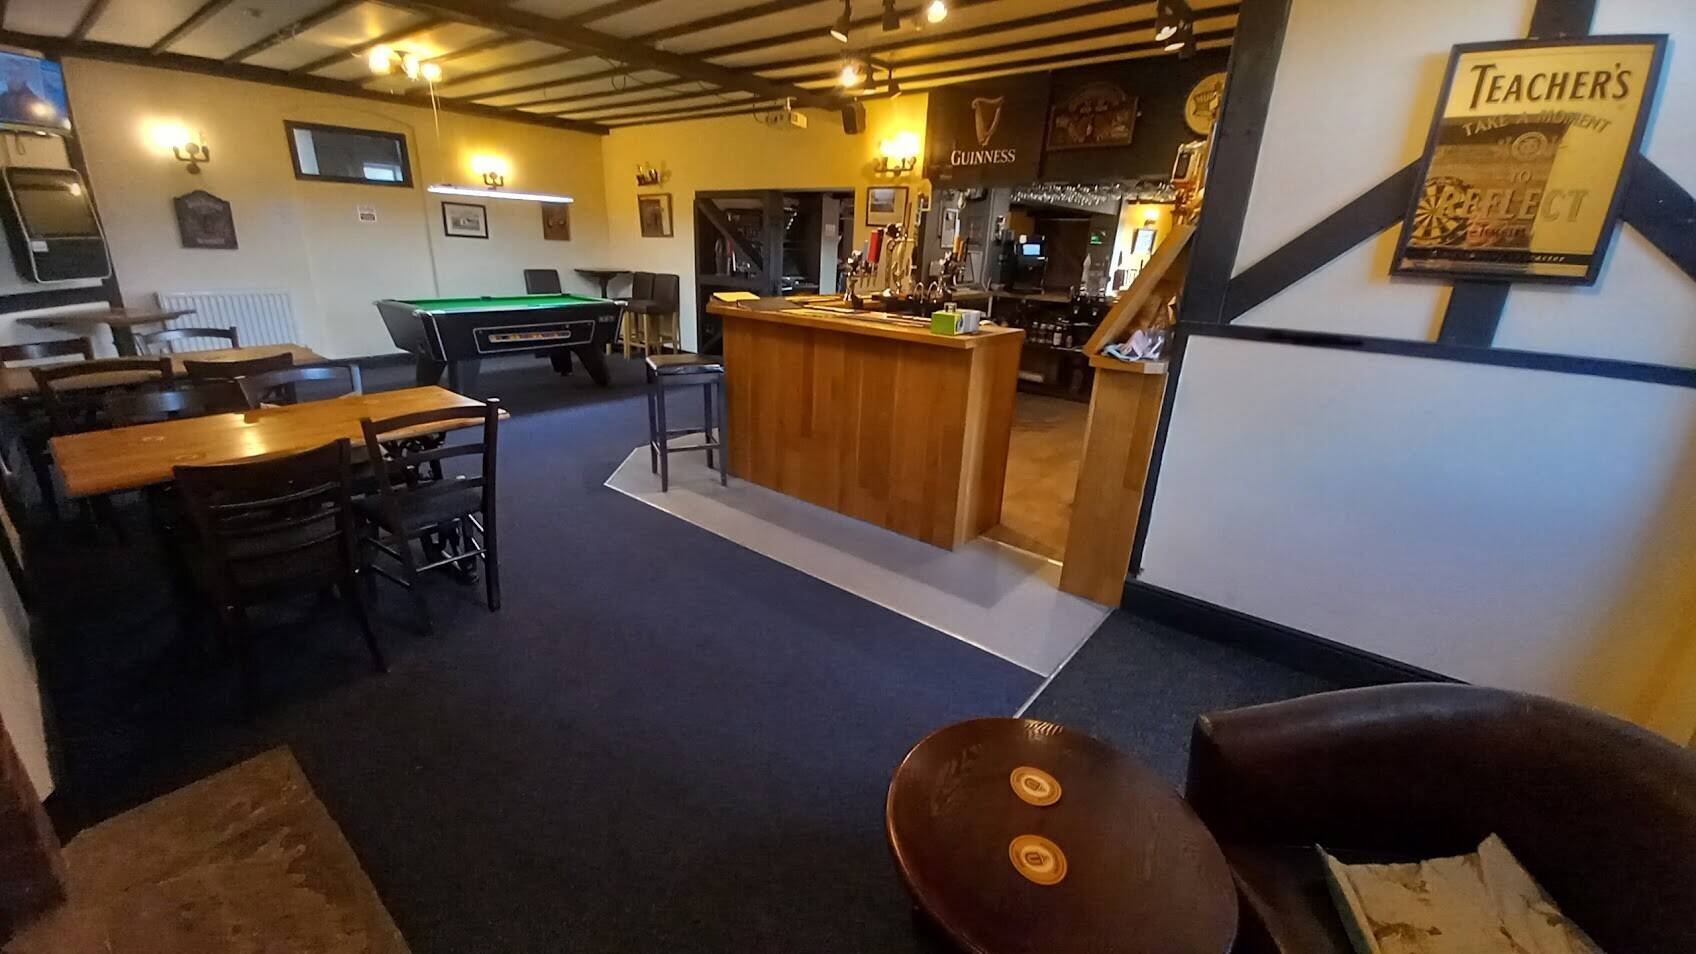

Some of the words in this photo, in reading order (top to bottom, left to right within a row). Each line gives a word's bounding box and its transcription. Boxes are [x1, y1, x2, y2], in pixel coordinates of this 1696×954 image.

[1469, 62, 1632, 110] TEACHER'S
[1462, 114, 1510, 137] TAKE
[1516, 111, 1529, 124] A
[1537, 110, 1612, 133] MOMENT
[950, 149, 1016, 166] GUINNESS
[1440, 187, 1591, 223] REFLECT
